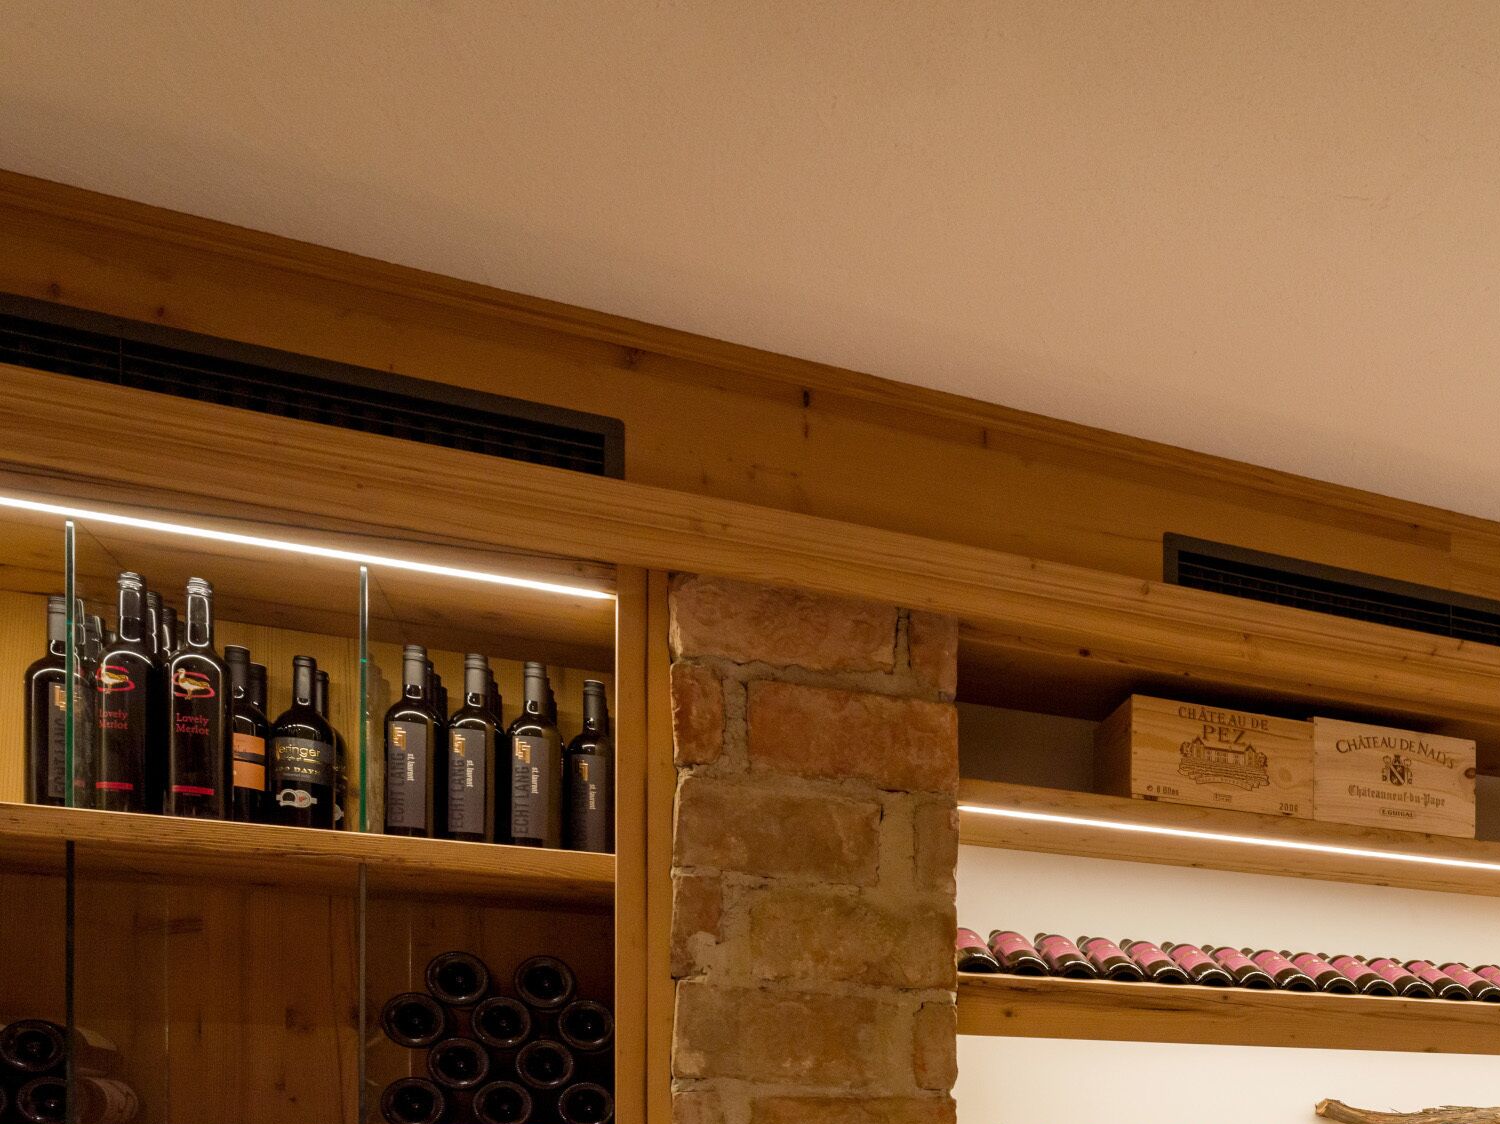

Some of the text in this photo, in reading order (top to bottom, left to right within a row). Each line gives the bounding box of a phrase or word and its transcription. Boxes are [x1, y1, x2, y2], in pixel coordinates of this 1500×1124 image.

[176, 712, 209, 726] Lovely
[1251, 718, 1269, 731] DE
[176, 724, 209, 736] Merlot
[1202, 724, 1246, 746] PEZ
[1335, 735, 1397, 754] CHÂTEAU
[1400, 738, 1417, 753] DE
[514, 766, 530, 801] LANG
